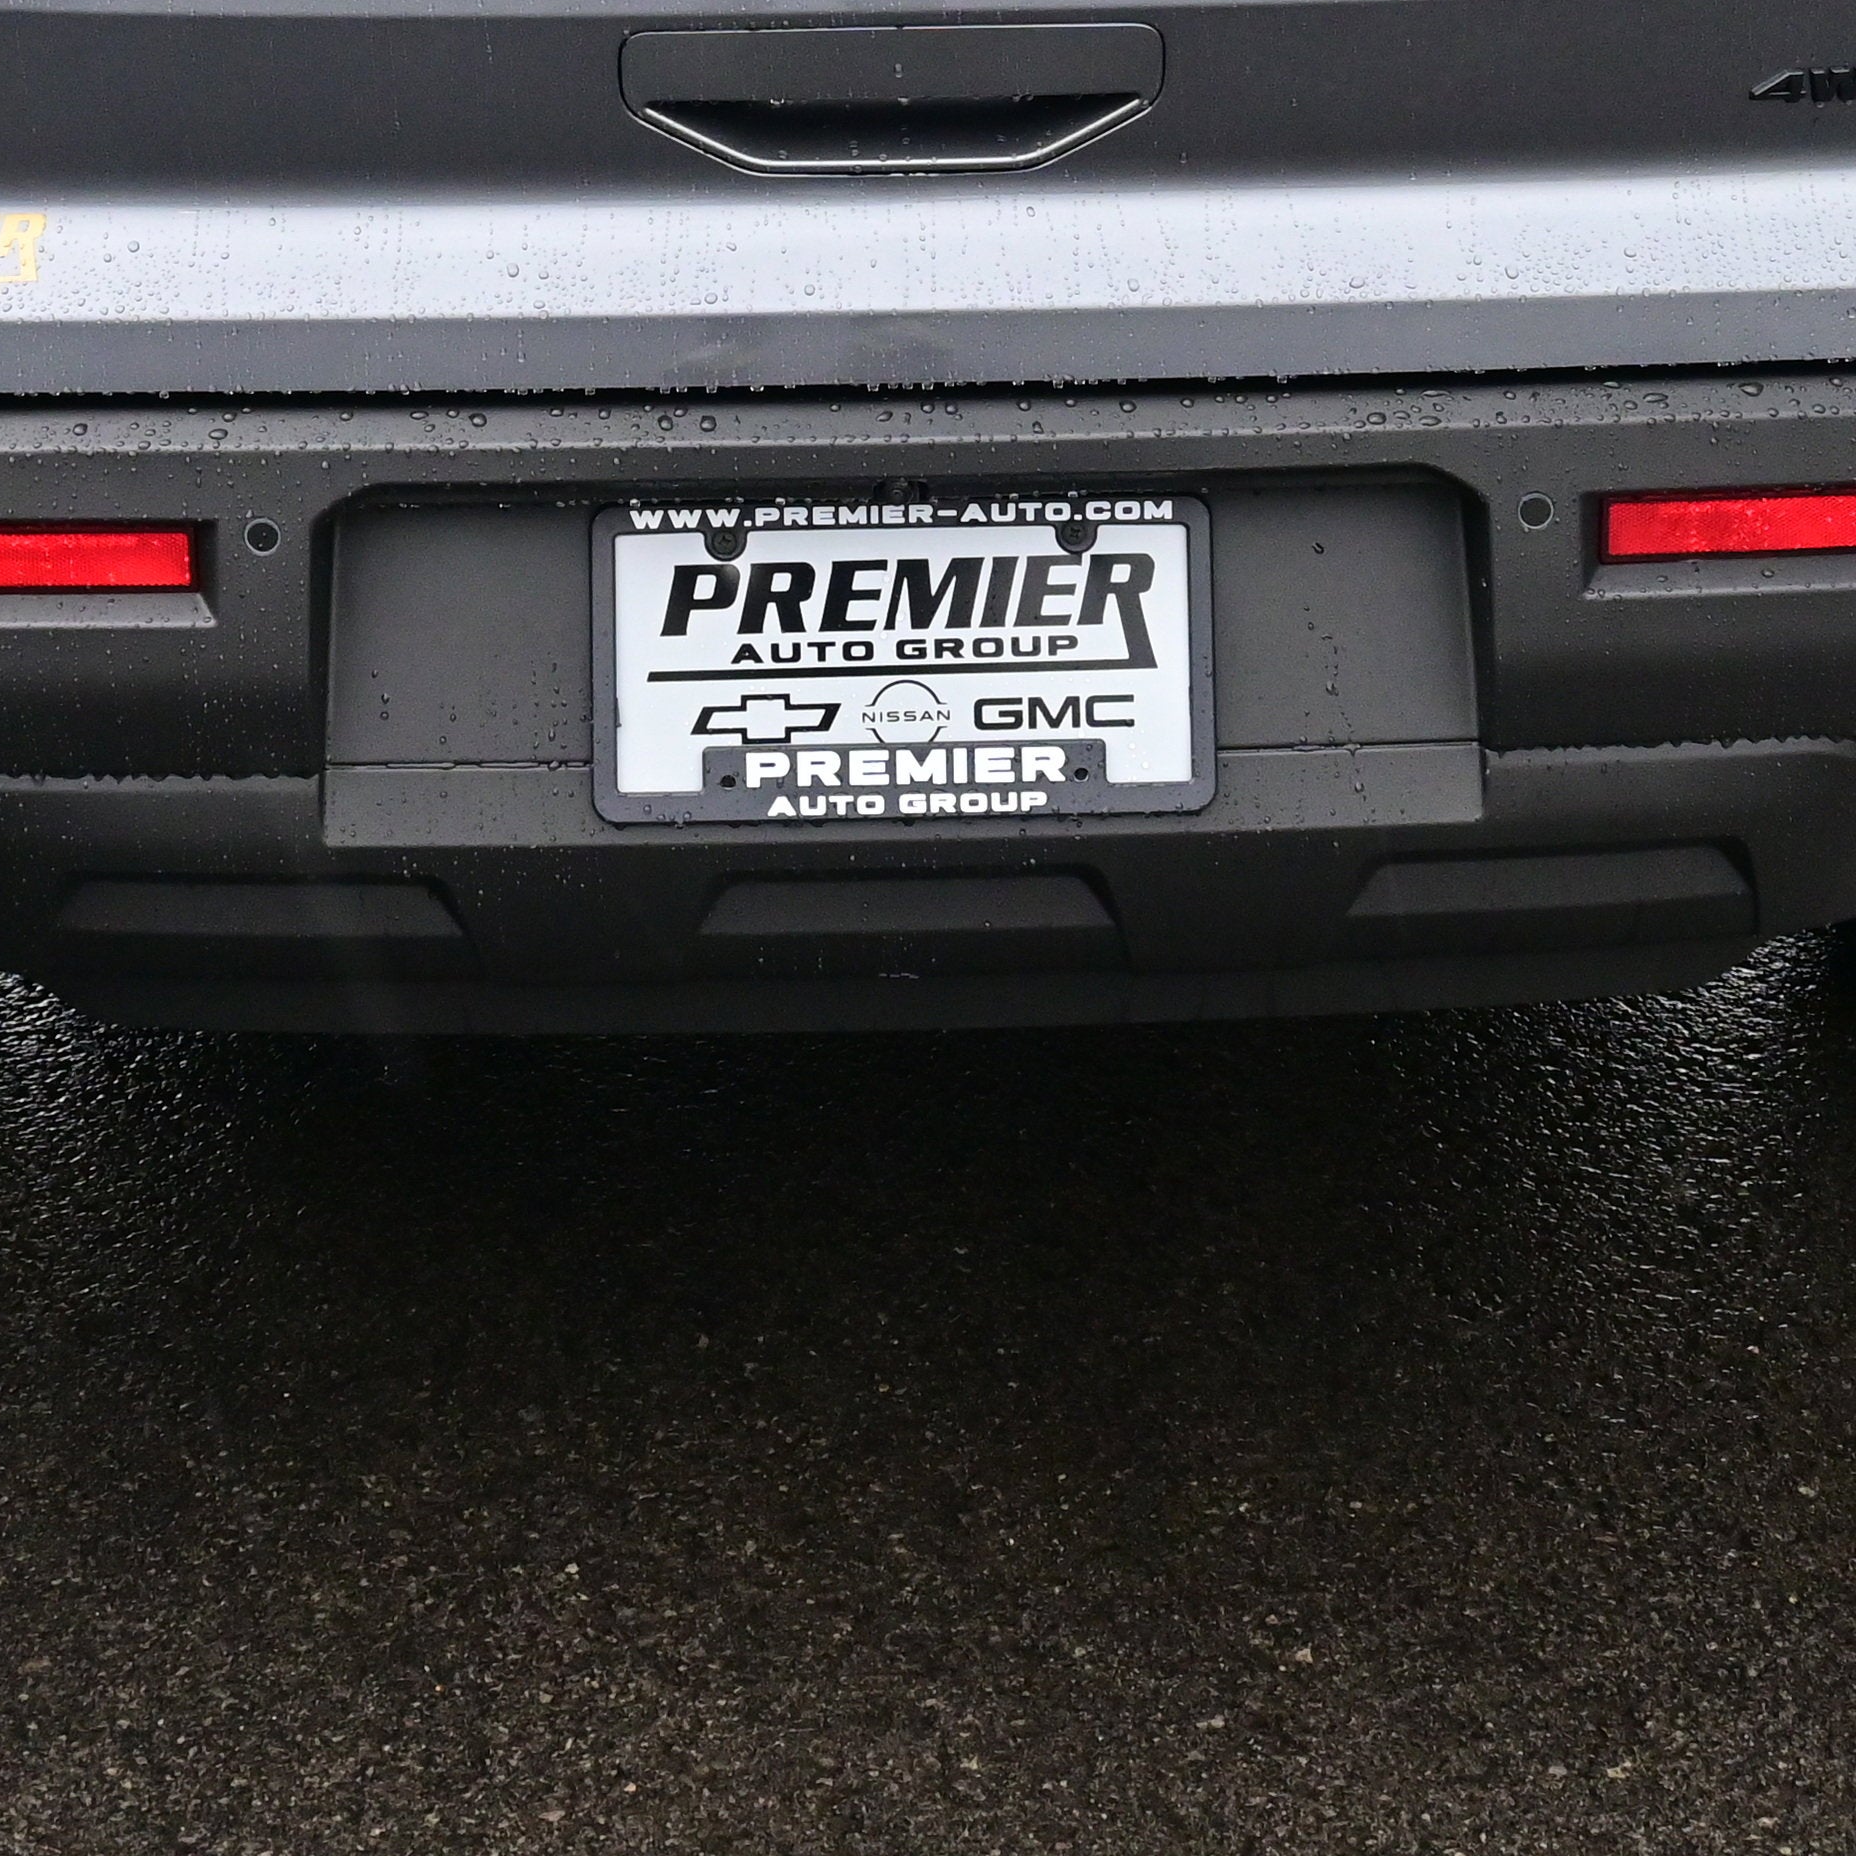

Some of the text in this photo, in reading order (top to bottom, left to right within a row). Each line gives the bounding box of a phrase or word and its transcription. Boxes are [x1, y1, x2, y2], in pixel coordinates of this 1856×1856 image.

[629, 500, 1173, 531] WWW.PREMIER-AUTO.COM
[660, 552, 1158, 668] PREMIER
[730, 634, 1080, 665] AUTO GROUP
[861, 693, 1136, 730] NISSAN GMC
[744, 745, 1067, 789] PREMIER
[767, 790, 1049, 818] AUTO GROUP
